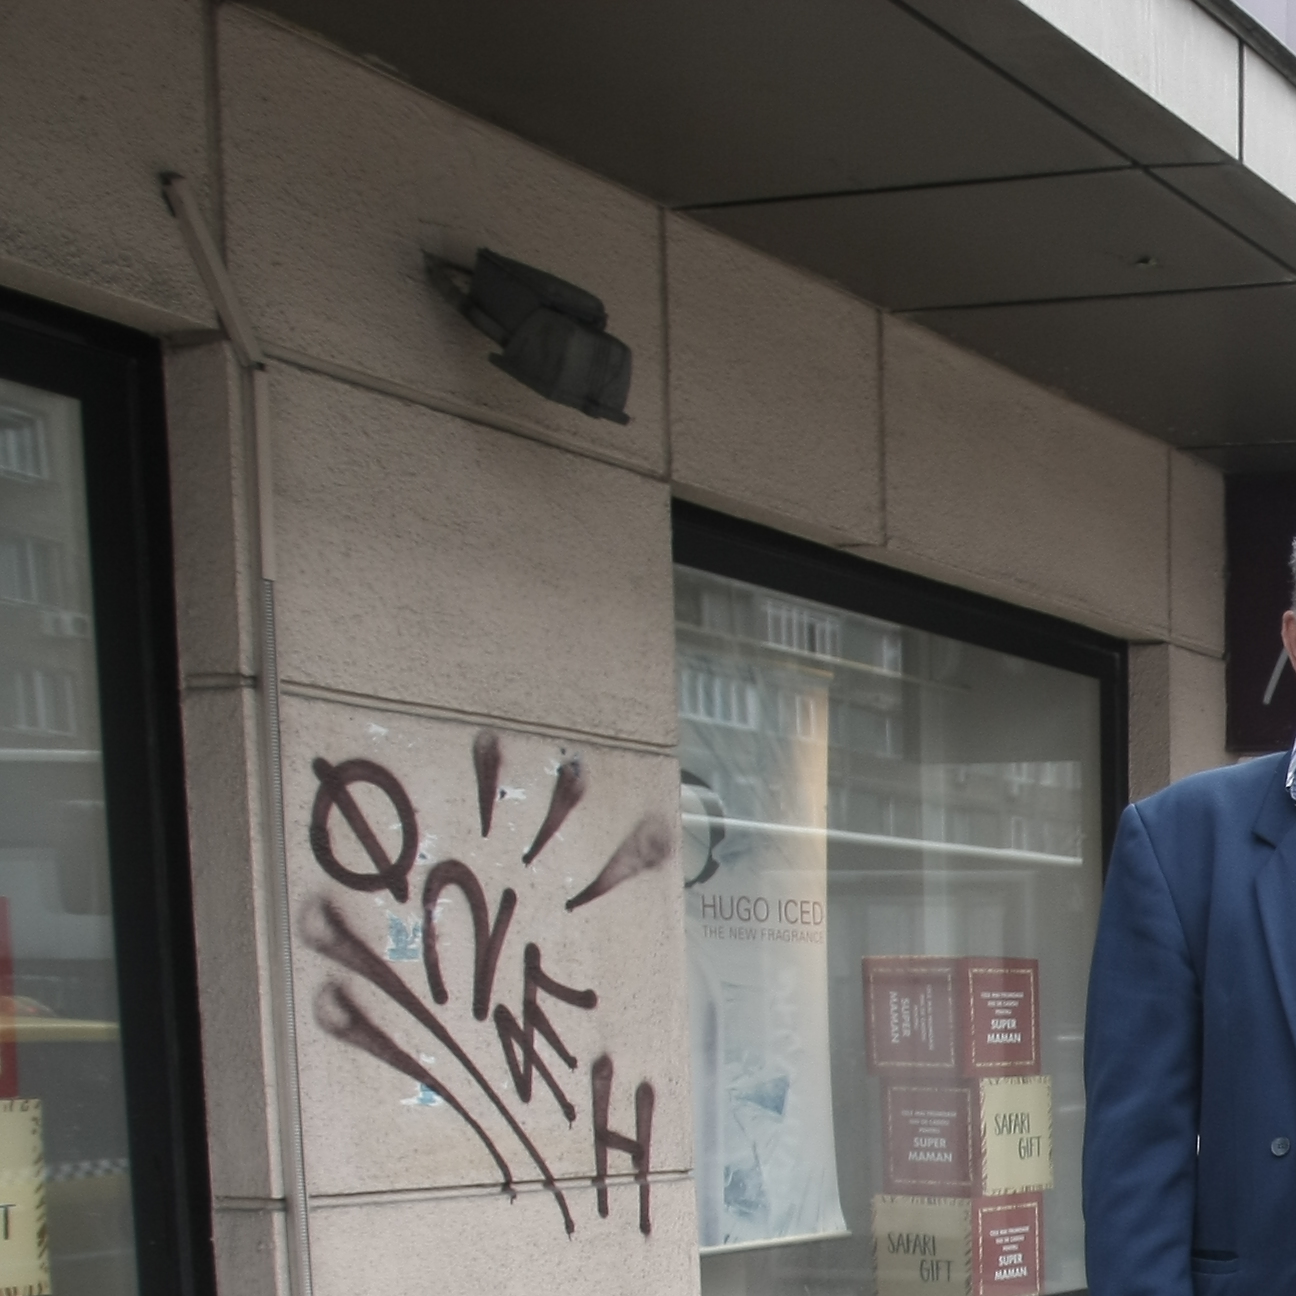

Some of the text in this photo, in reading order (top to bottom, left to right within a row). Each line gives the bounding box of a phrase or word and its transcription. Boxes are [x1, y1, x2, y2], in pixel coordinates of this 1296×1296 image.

[702, 895, 823, 926] HUGO ICED
[703, 925, 823, 943] THE NEW FRAGRANCE
[991, 1018, 1017, 1031] SUPER
[987, 1033, 1021, 1045] MAMAN
[994, 1112, 1030, 1136] SAFARI
[913, 1137, 946, 1149] SUPER
[1018, 1136, 1042, 1160] GIFT
[908, 1151, 952, 1163] MAMAN
[887, 1232, 936, 1257] SAFARI
[999, 1253, 1023, 1267] SUPER
[920, 1259, 954, 1283] GIFT
[994, 1266, 1027, 1282] MAMAN
